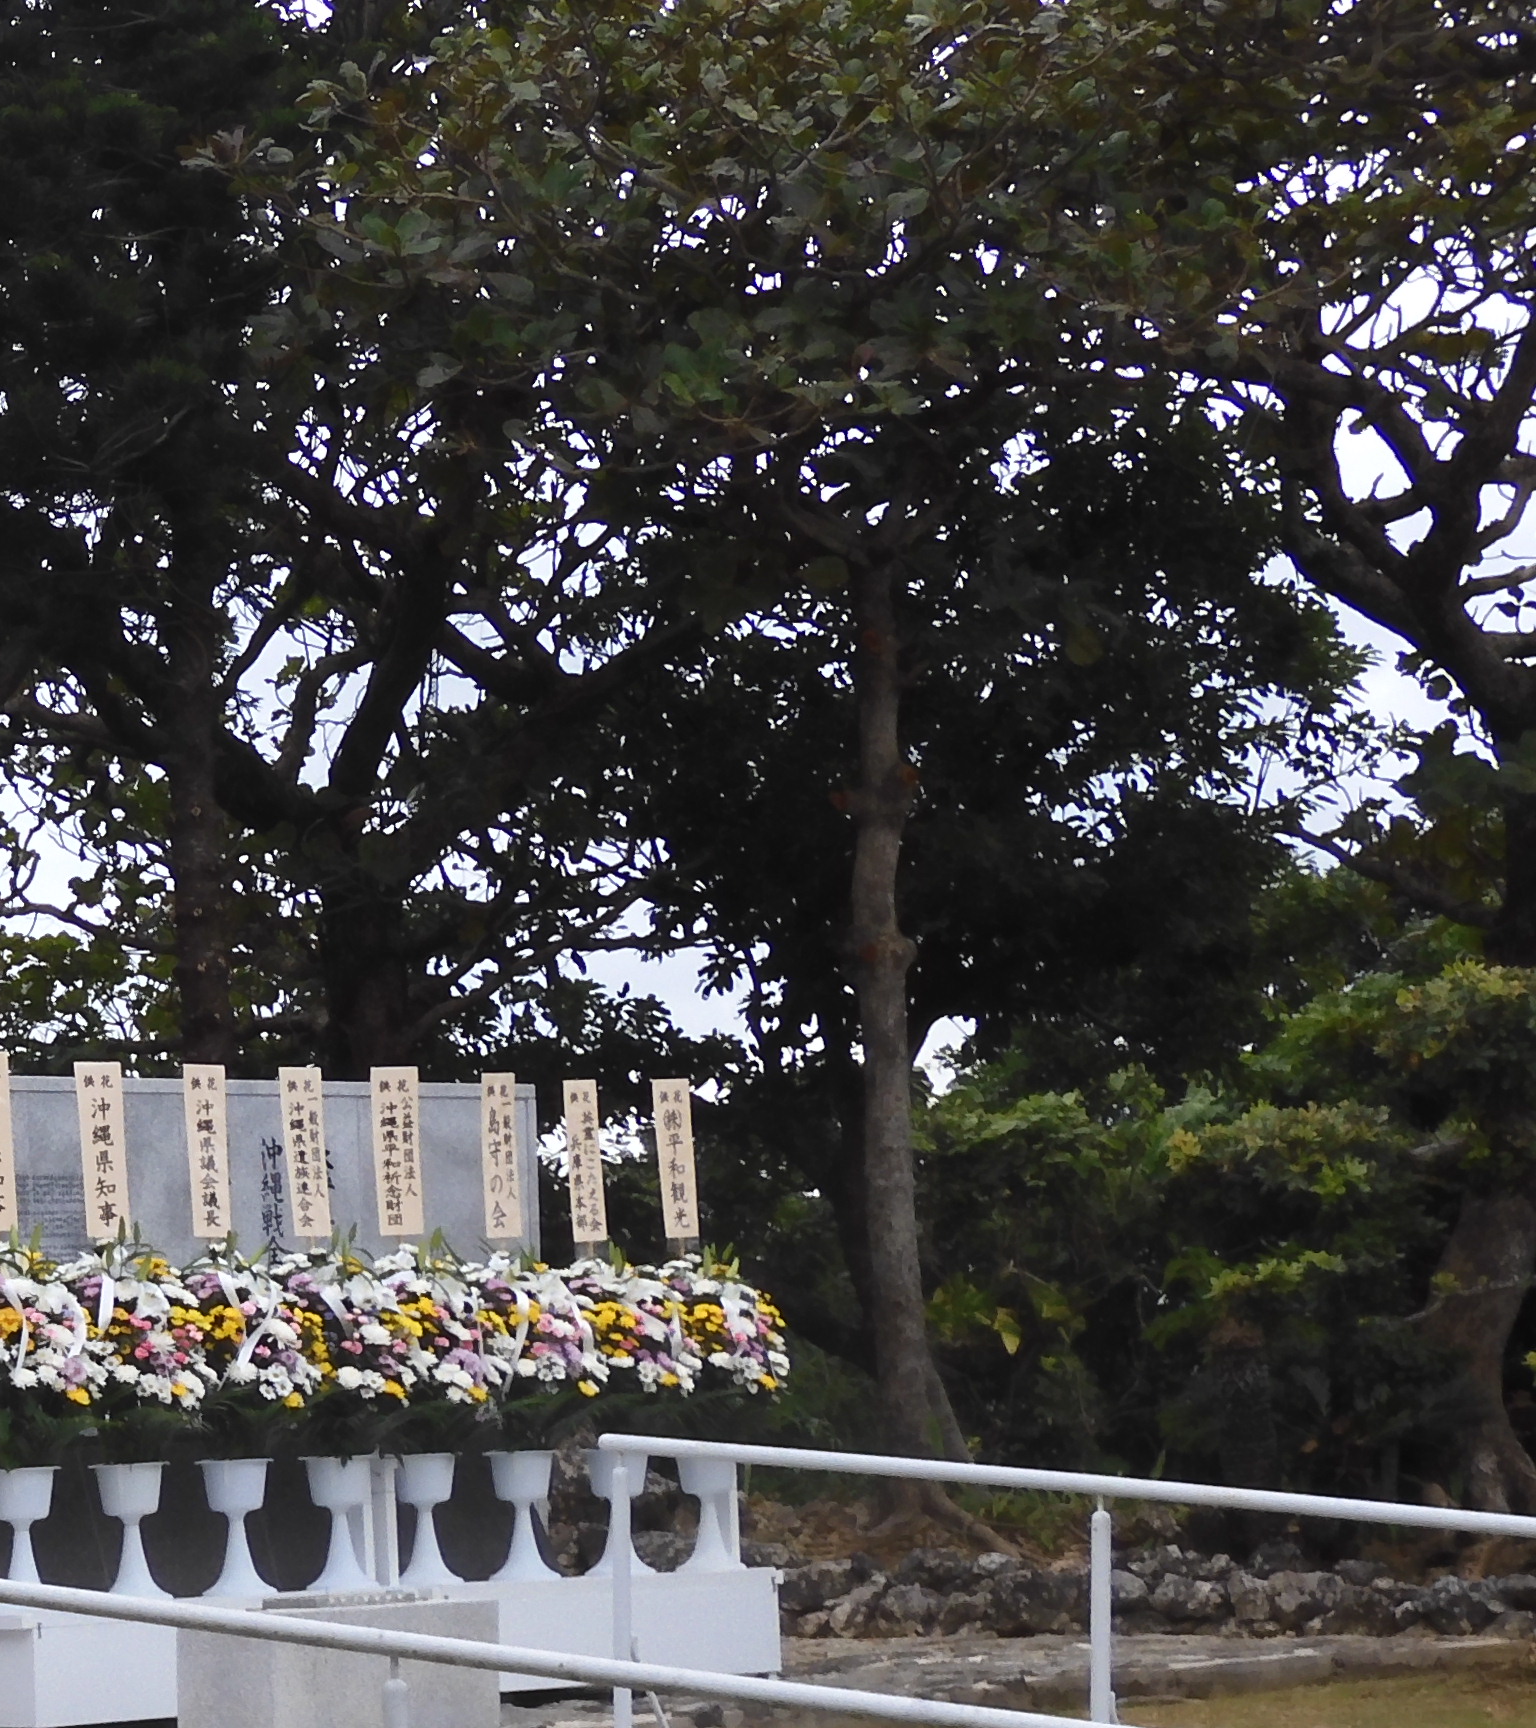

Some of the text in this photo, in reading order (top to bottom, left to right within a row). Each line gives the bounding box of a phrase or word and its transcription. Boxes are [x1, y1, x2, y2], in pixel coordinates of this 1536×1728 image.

[84, 1075, 114, 1089] 供花
[191, 1076, 218, 1091] 供花
[91, 1097, 119, 1227] 沖縄県知事
[196, 1099, 221, 1228] 沖縄県議会議長
[289, 1102, 315, 1227] 沖縄県遺族連合会
[380, 1102, 403, 1226] 沖縄県平和祈念財団
[401, 1096, 418, 1197] 公益財団法人
[488, 1107, 507, 1228] 島守の会
